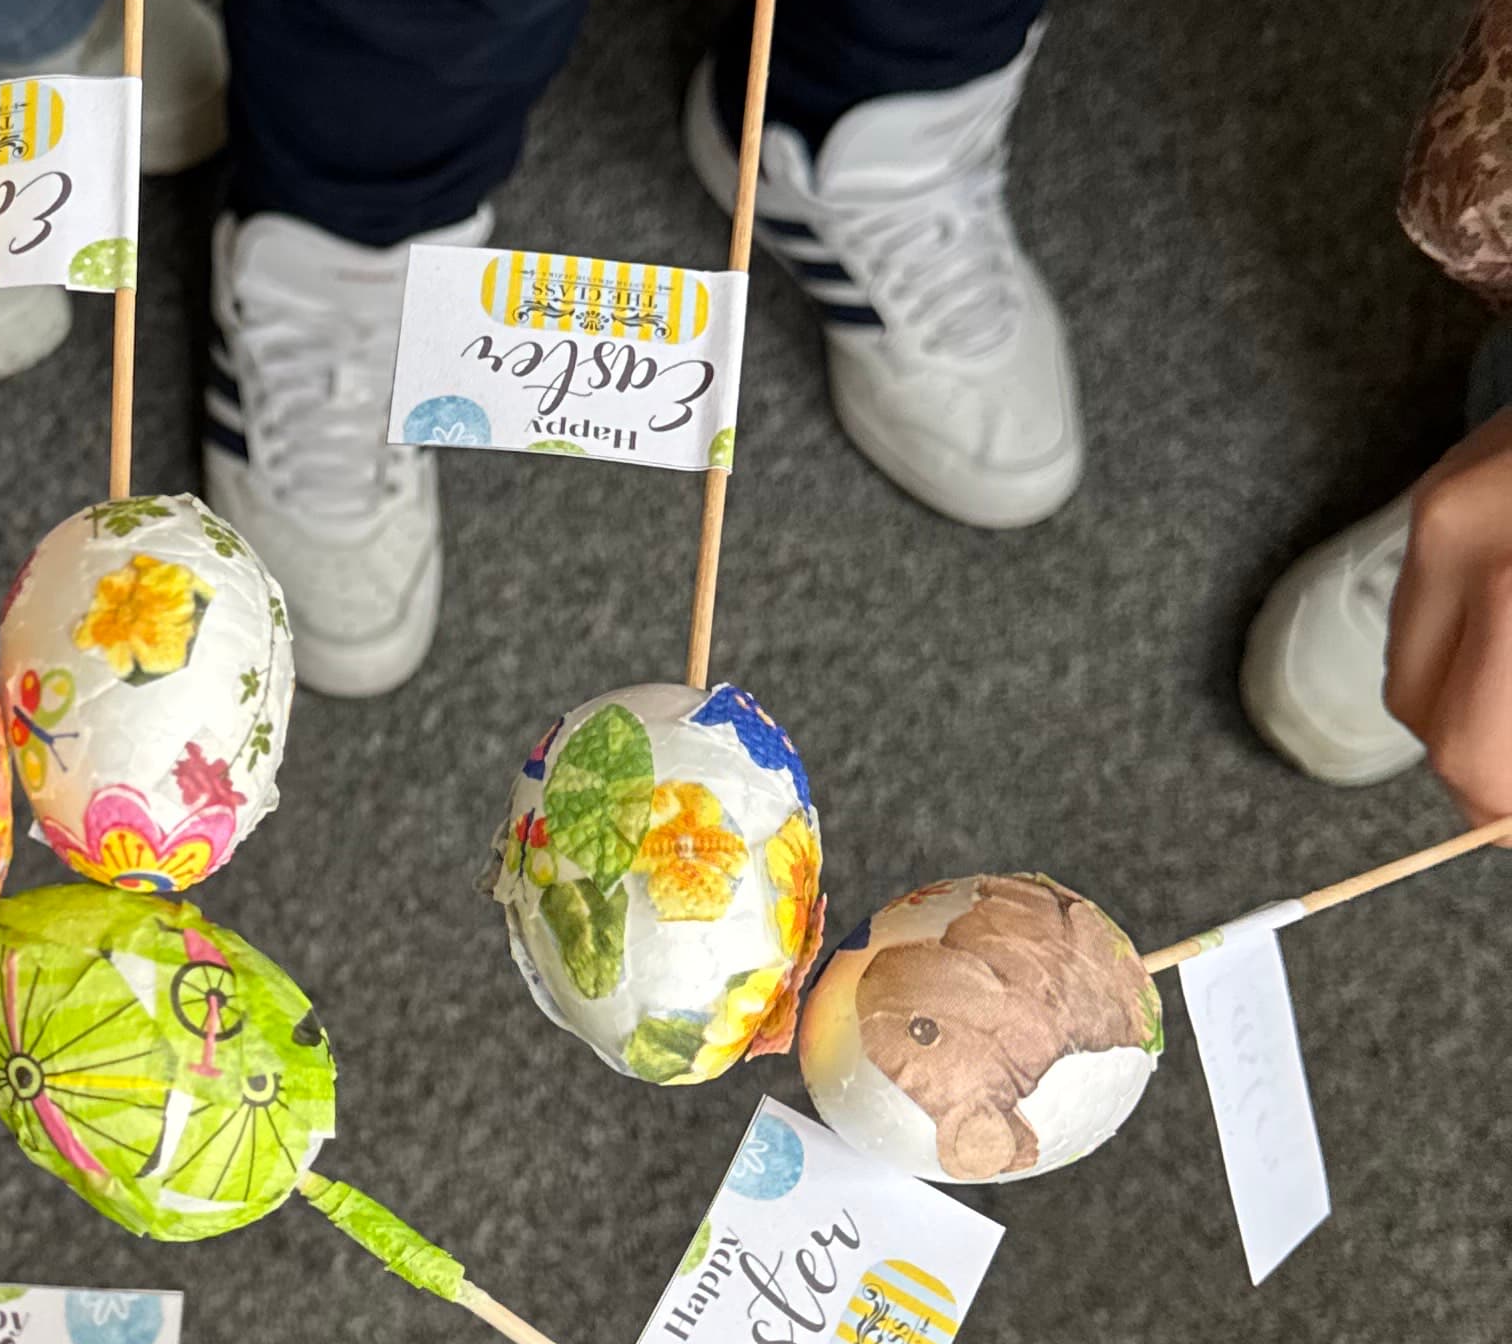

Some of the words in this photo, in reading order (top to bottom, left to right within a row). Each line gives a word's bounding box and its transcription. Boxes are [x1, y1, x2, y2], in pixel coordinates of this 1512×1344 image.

[532, 284, 601, 300] CLASS
[608, 291, 657, 308] THE
[460, 335, 715, 433] Easter
[524, 416, 638, 451] Happy
[663, 1226, 744, 1342] Happy
